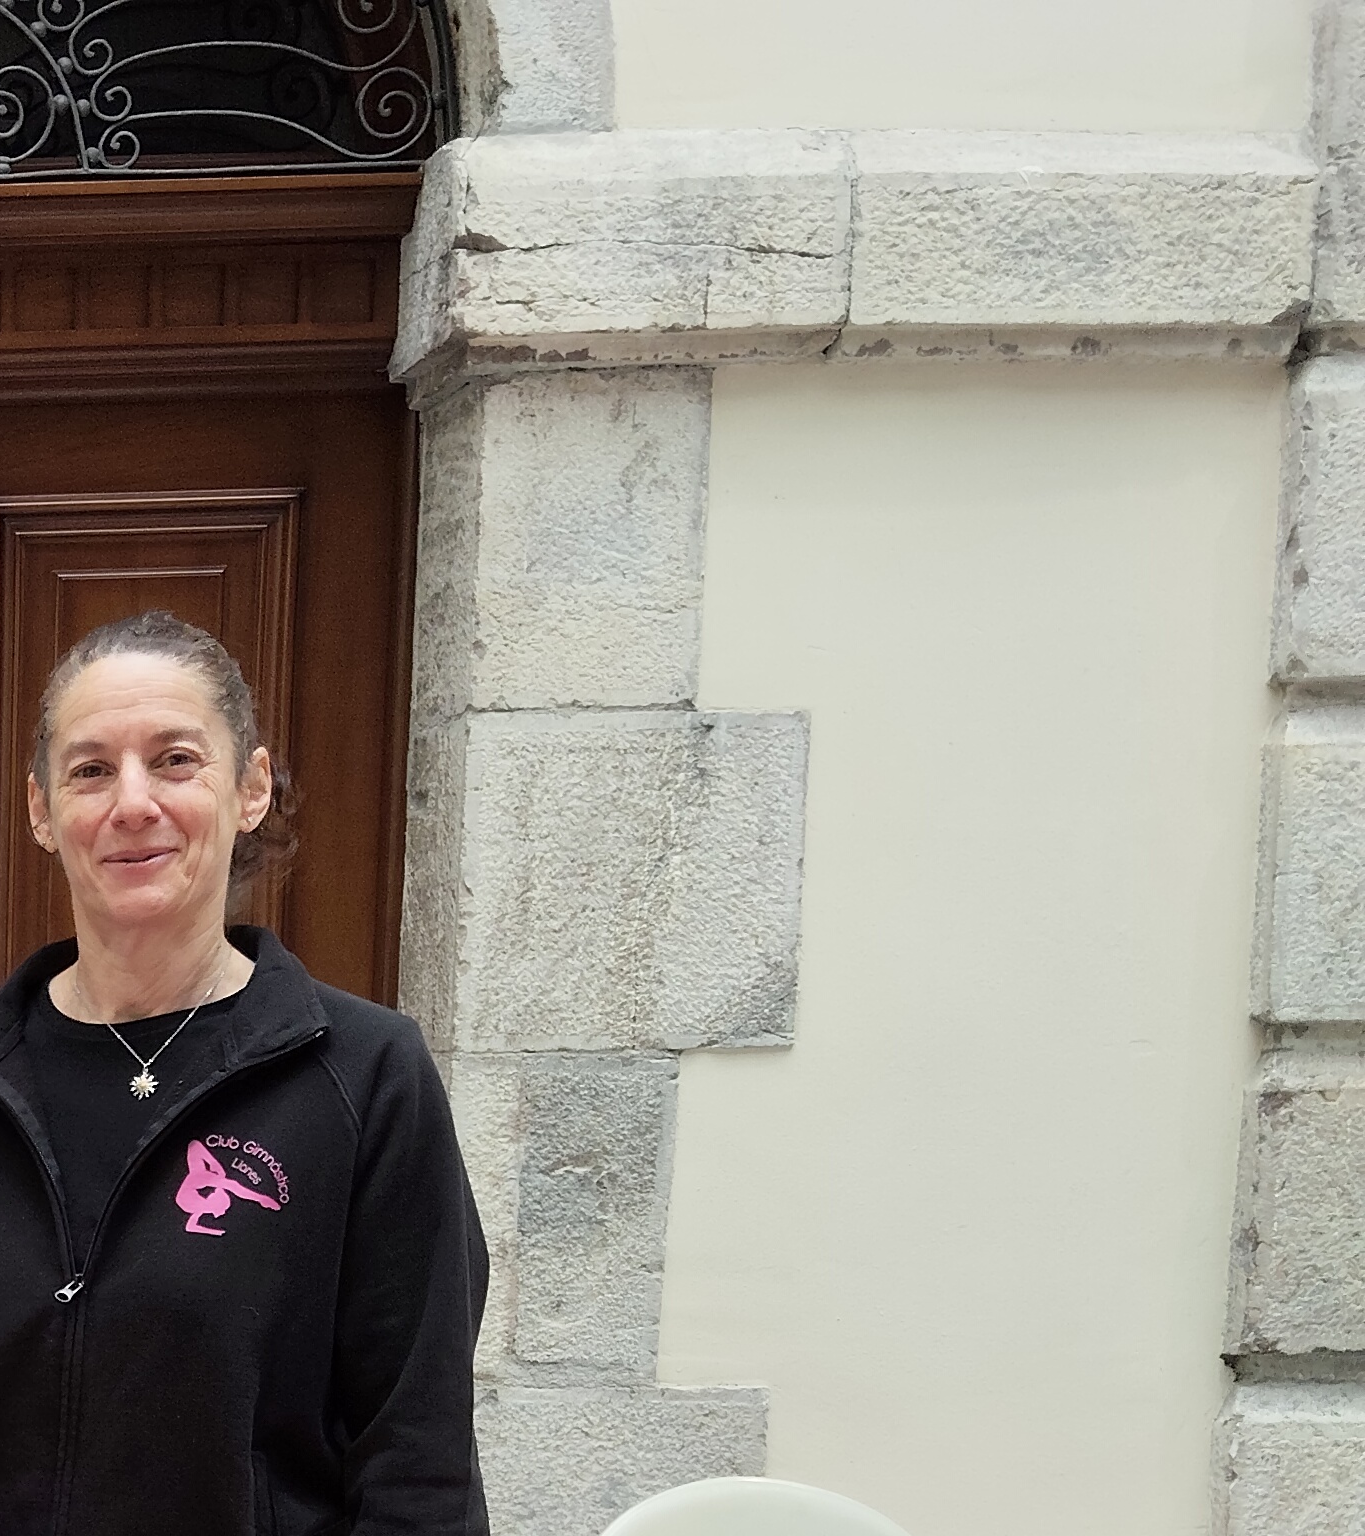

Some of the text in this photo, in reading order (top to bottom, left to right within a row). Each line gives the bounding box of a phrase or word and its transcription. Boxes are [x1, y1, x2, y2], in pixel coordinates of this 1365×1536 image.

[205, 1134, 290, 1204] Club Gimnástico
[231, 1157, 262, 1186] Llanes
